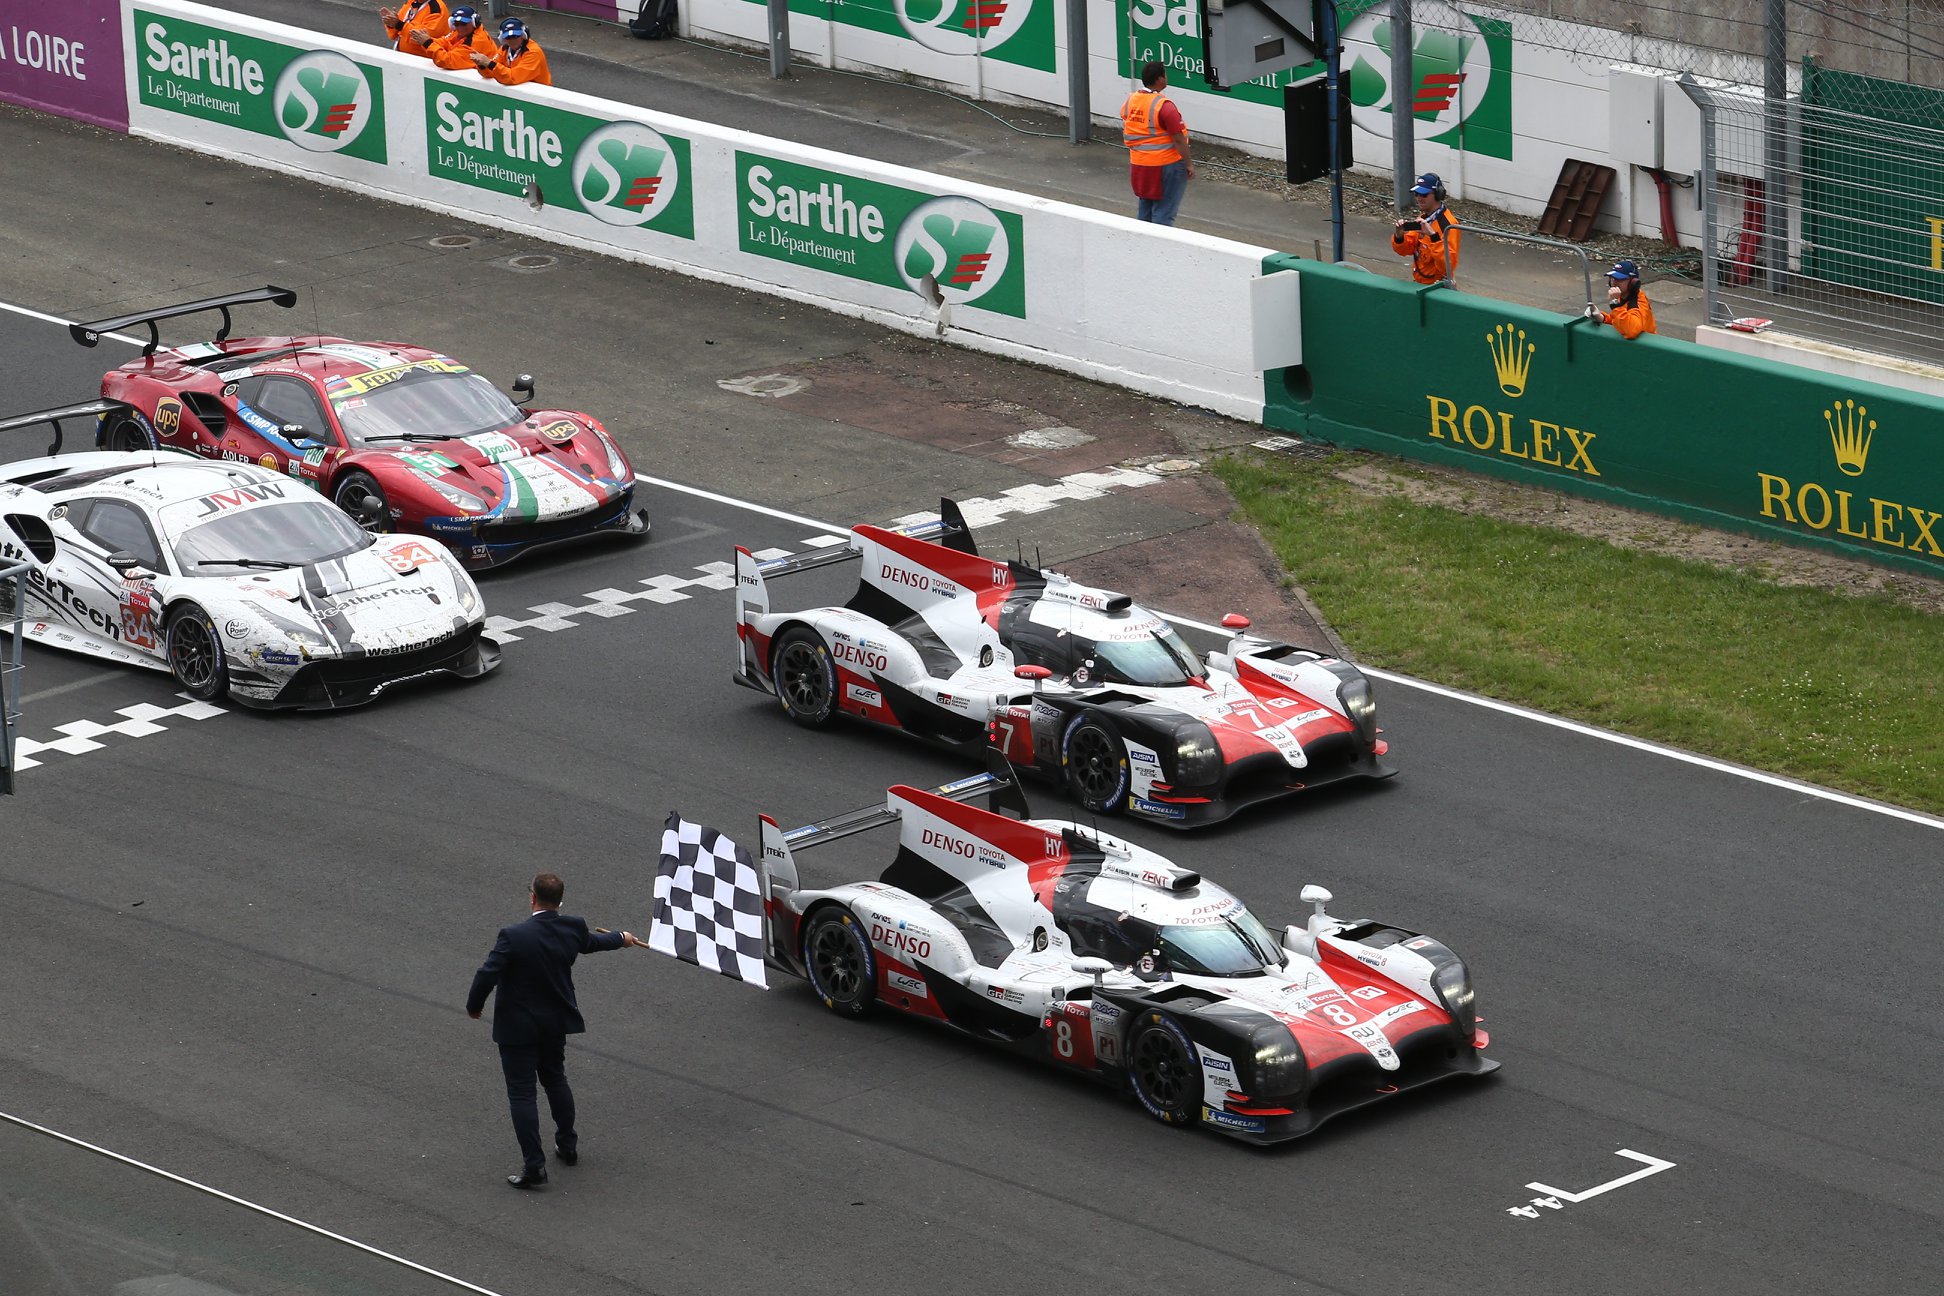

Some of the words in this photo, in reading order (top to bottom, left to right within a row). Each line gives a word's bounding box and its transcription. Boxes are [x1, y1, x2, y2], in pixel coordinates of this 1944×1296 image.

[12, 26, 86, 81] LOIRE
[145, 22, 265, 95] Sarthe
[1128, 36, 1154, 63] Le
[148, 75, 163, 96] Le
[166, 80, 241, 116] Département
[435, 91, 563, 167] Sarthe
[437, 146, 454, 168] Le
[457, 151, 537, 186] Département
[747, 165, 885, 243] Sarthe
[748, 221, 766, 243] Le
[769, 226, 857, 265] Département
[158, 408, 178, 430] ups
[247, 413, 271, 433] SMP
[547, 422, 574, 438] ups
[1426, 395, 1601, 476] ROLEX
[222, 450, 250, 464] ADLER
[303, 448, 326, 466] PRO
[300, 467, 318, 478] TOTAL
[197, 483, 285, 518] JMW
[201, 505, 246, 523] motorsport
[1757, 472, 1944, 558] ROLEX
[385, 546, 434, 573] 84
[741, 575, 759, 587] JTEKT
[881, 564, 929, 591] DENSO
[932, 578, 957, 592] TOYOTA
[993, 567, 1008, 586] HY
[931, 587, 957, 600] HYBRID
[1080, 594, 1104, 609] ZENT
[130, 597, 149, 609] TOTAL
[307, 585, 435, 621] WeatherTech
[122, 607, 153, 646] 84
[1123, 619, 1161, 633] DENSO
[367, 631, 453, 657] WeatherTech
[833, 642, 888, 671] DENSO
[855, 688, 877, 700] WEC
[937, 695, 951, 706] GR
[1034, 703, 1060, 718] RAYS
[1236, 708, 1265, 728] 7
[1000, 721, 1014, 755] 7
[1132, 752, 1155, 762] AISIN
[1142, 804, 1179, 815] MICHELIN
[766, 847, 786, 859] JTEKT
[922, 829, 975, 859] DENSO
[1045, 837, 1062, 857] HY
[978, 846, 1006, 861] TOYOTA
[978, 856, 1006, 870] HYBRID
[1141, 870, 1169, 888] ZENT
[1191, 898, 1233, 916] DENSO
[1176, 915, 1222, 925] TOYOTA
[871, 924, 931, 958] DENSO
[1357, 955, 1380, 967] HYBRID
[1381, 957, 1388, 967] 8
[897, 976, 921, 989] WEC
[987, 989, 1004, 1000] GR
[1311, 992, 1341, 1003] TOTAL
[1357, 987, 1380, 998] P1
[1092, 1001, 1121, 1018] RAYS
[1322, 1004, 1358, 1026] 8
[1056, 1020, 1073, 1058] 8
[1101, 1036, 1115, 1056] P1
[1204, 1058, 1229, 1070] AISIN
[1217, 1115, 1259, 1128] MICHELIN
